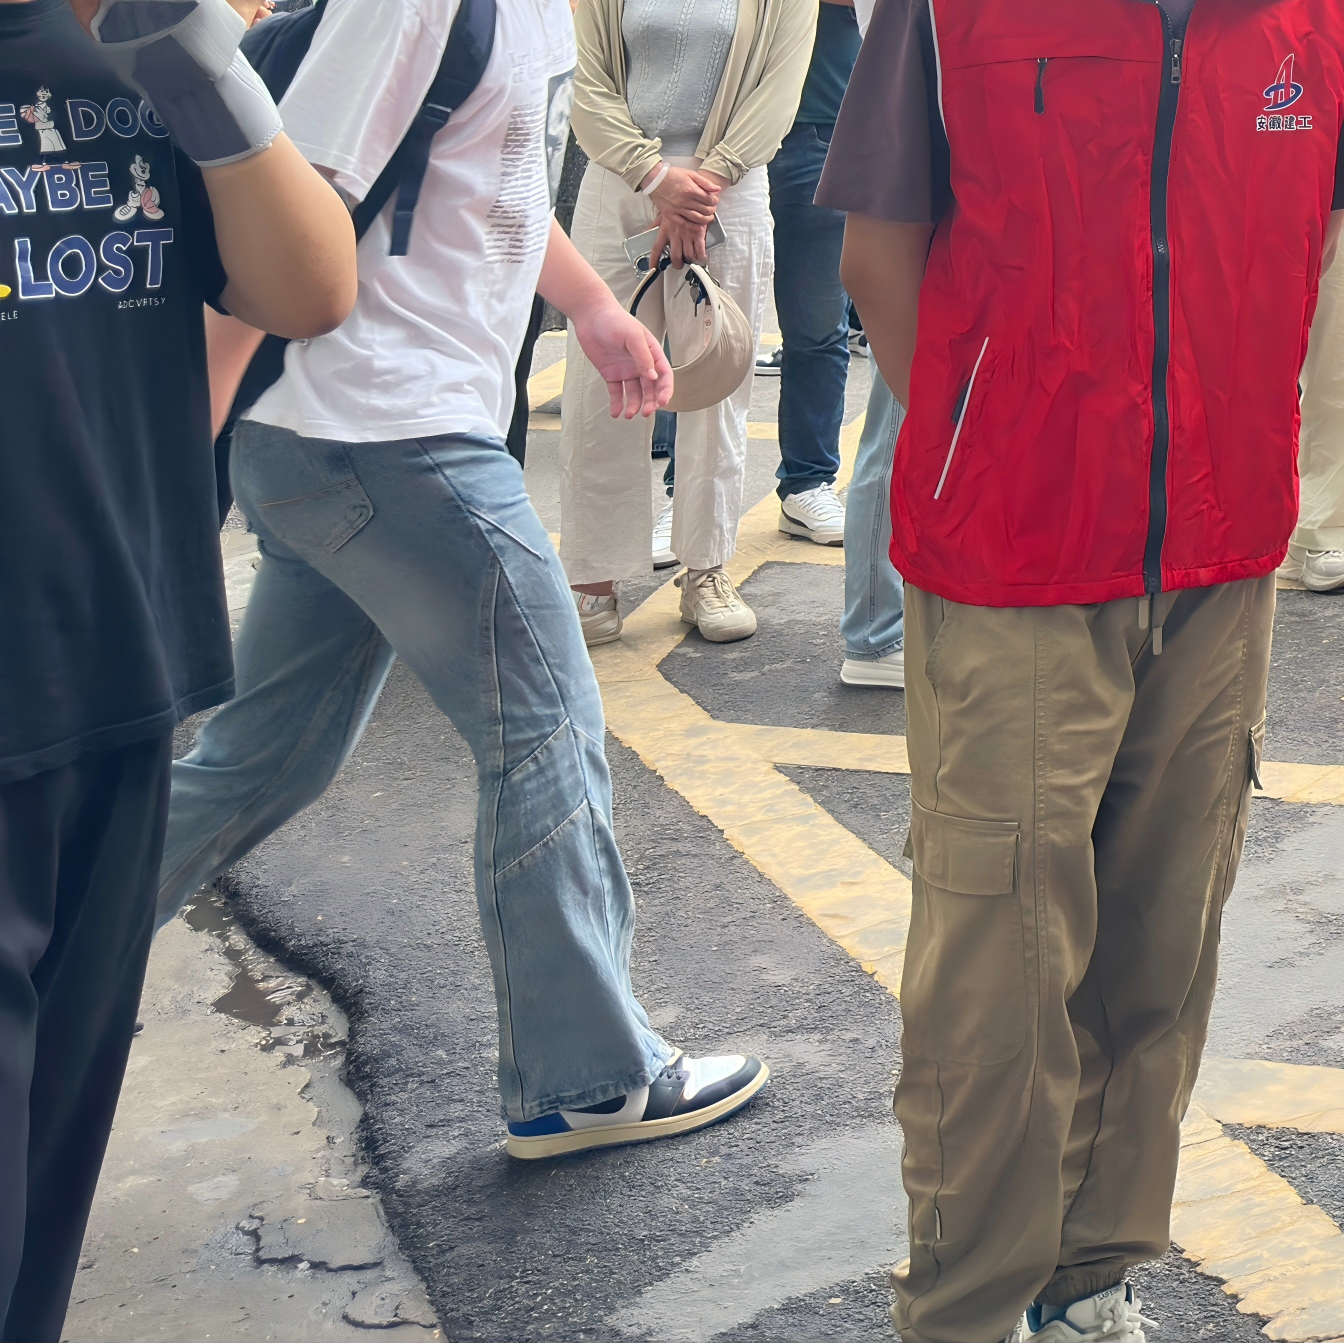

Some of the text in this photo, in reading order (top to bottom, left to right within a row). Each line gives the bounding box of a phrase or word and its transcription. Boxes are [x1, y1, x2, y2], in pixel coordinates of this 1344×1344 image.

[1256, 115, 1313, 131] 安徽建工
[15, 228, 174, 299] LOST
